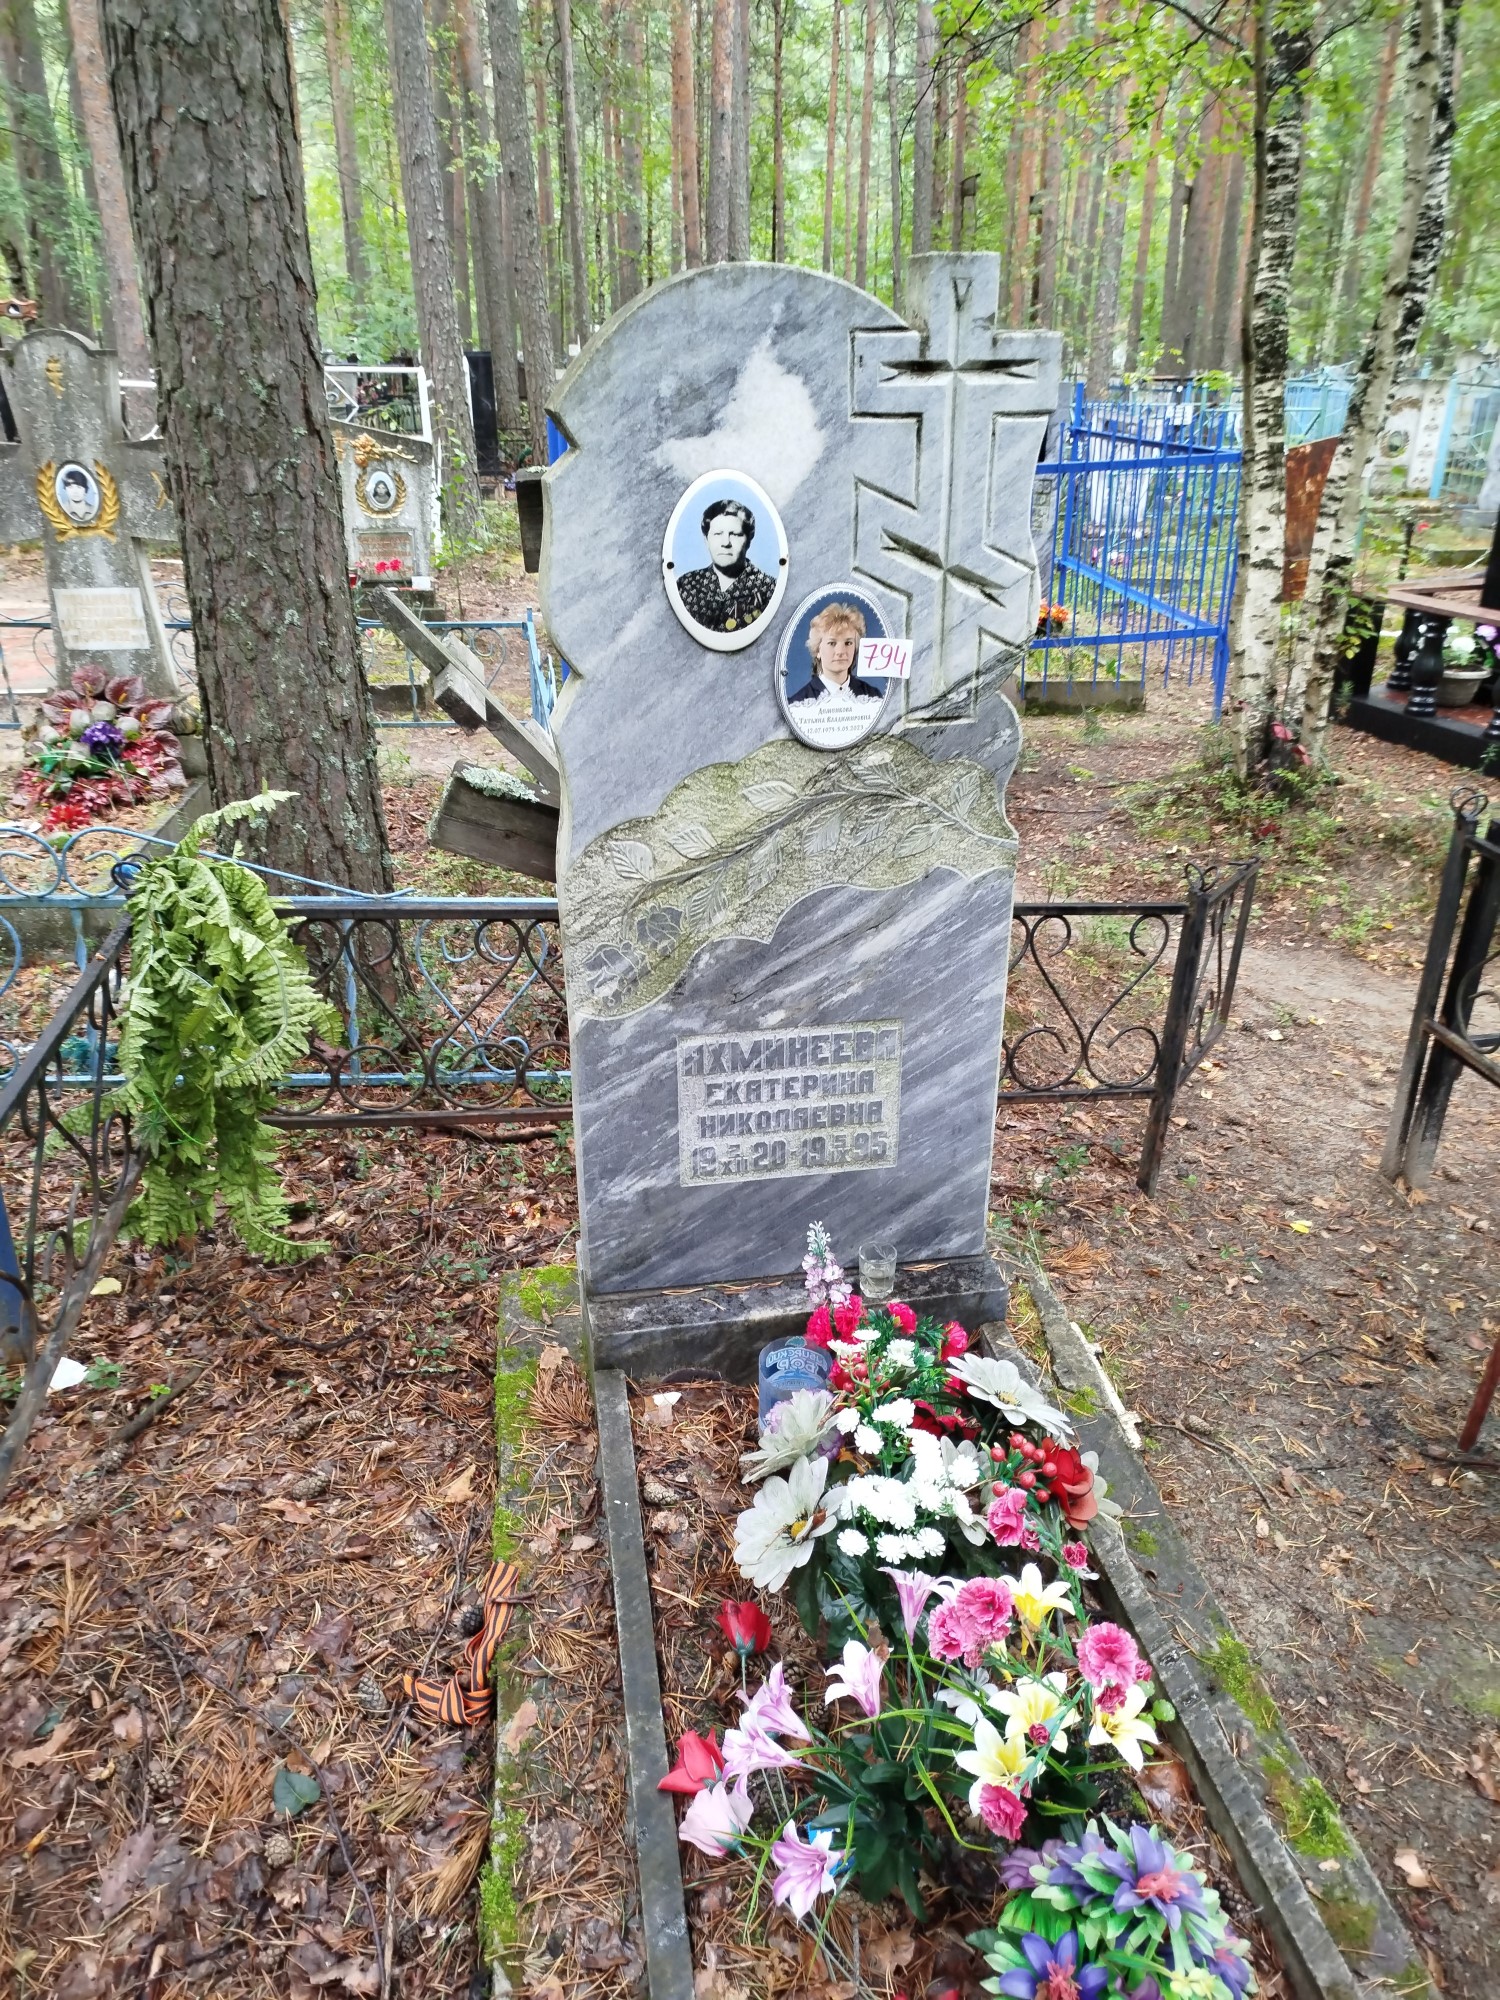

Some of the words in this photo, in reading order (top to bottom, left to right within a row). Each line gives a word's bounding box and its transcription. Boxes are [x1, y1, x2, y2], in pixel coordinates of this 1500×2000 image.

[863, 644, 907, 677] 794
[706, 1070, 876, 1106] ЕКАТЕРИНА
[699, 1101, 883, 1138] НИКОЛАЕВНА
